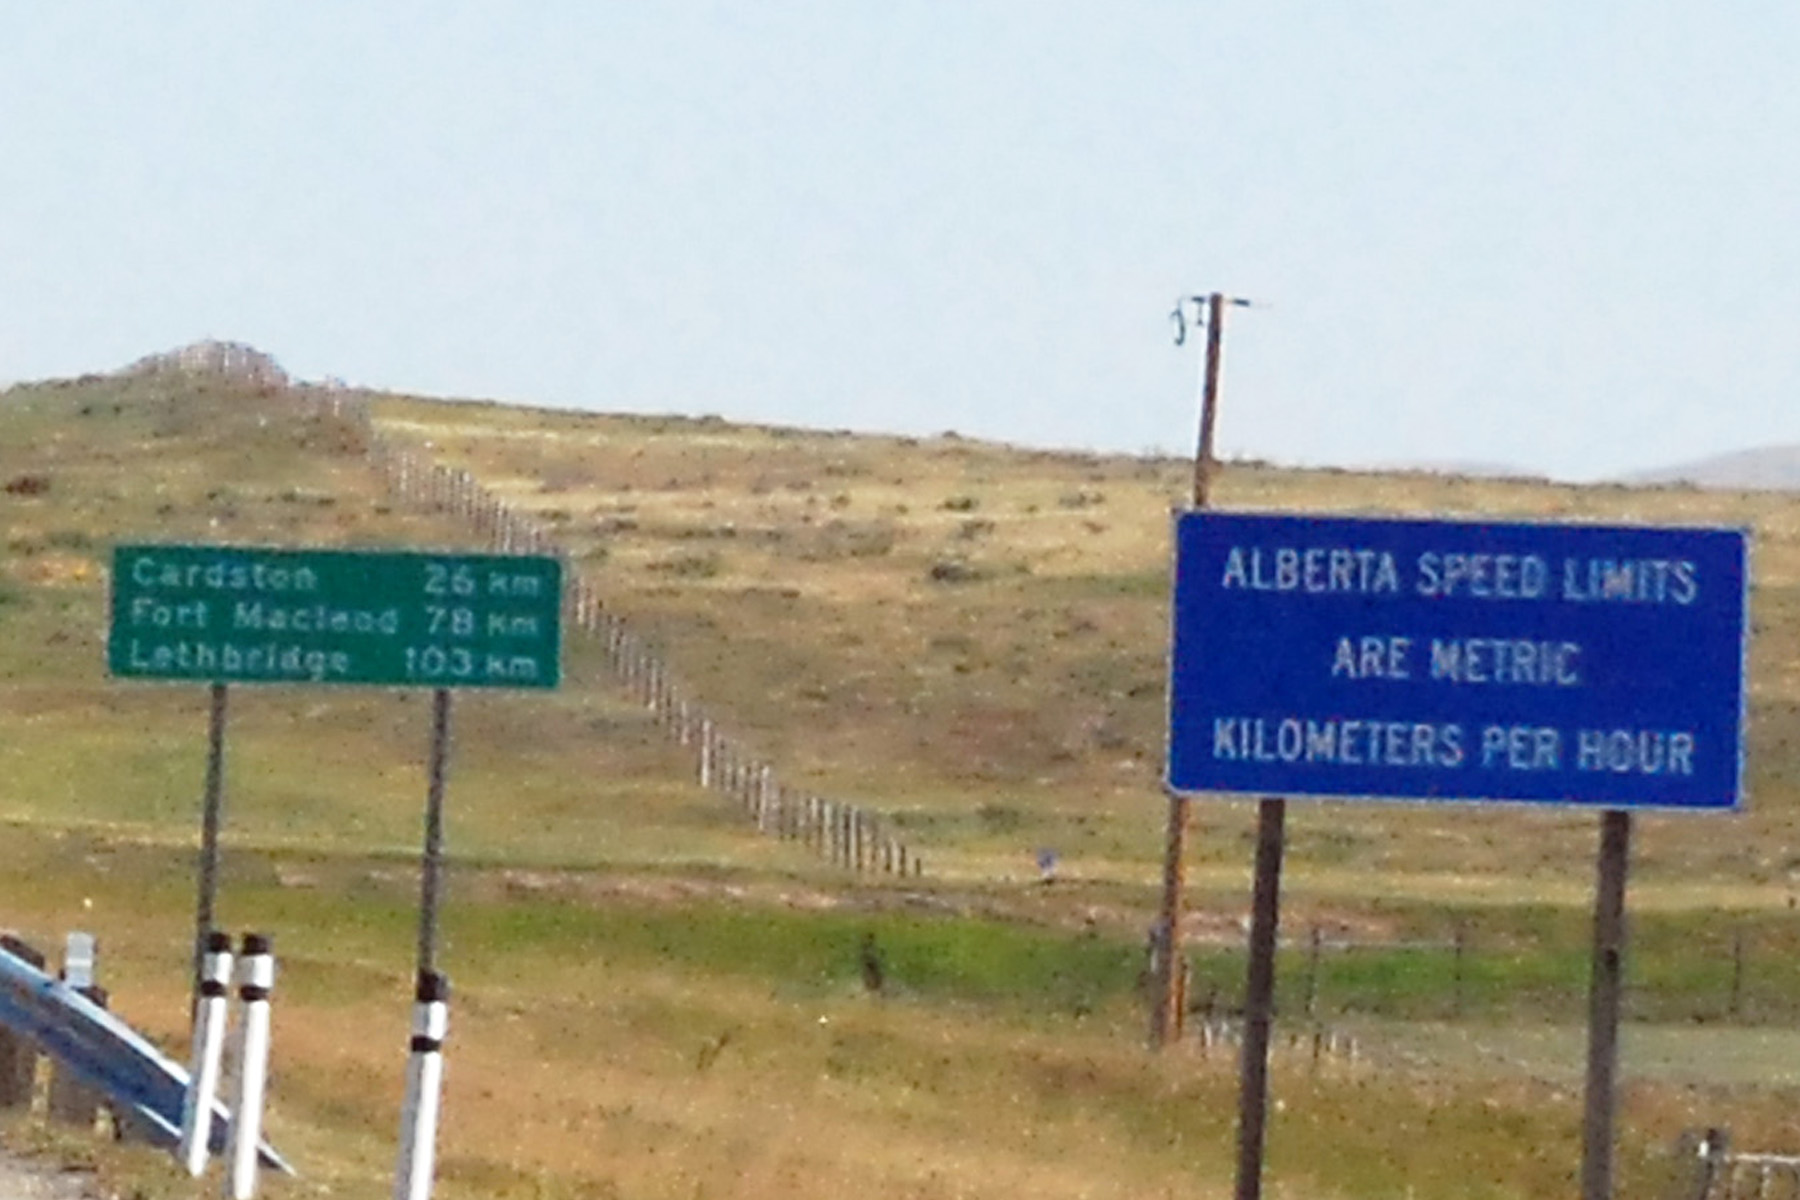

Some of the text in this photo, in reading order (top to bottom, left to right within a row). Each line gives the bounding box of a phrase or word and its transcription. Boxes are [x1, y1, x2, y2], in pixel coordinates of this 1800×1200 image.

[133, 557, 540, 595] Cardston 26 km
[1223, 549, 1696, 604] ALBERTA SPEED LIMITS
[131, 599, 537, 634] Fort Macleod 78 km
[130, 642, 535, 679] Lethbridge 103 km
[1333, 638, 1579, 685] ARE METRIC
[1214, 718, 1694, 774] KILOMETERS PER HOUR
